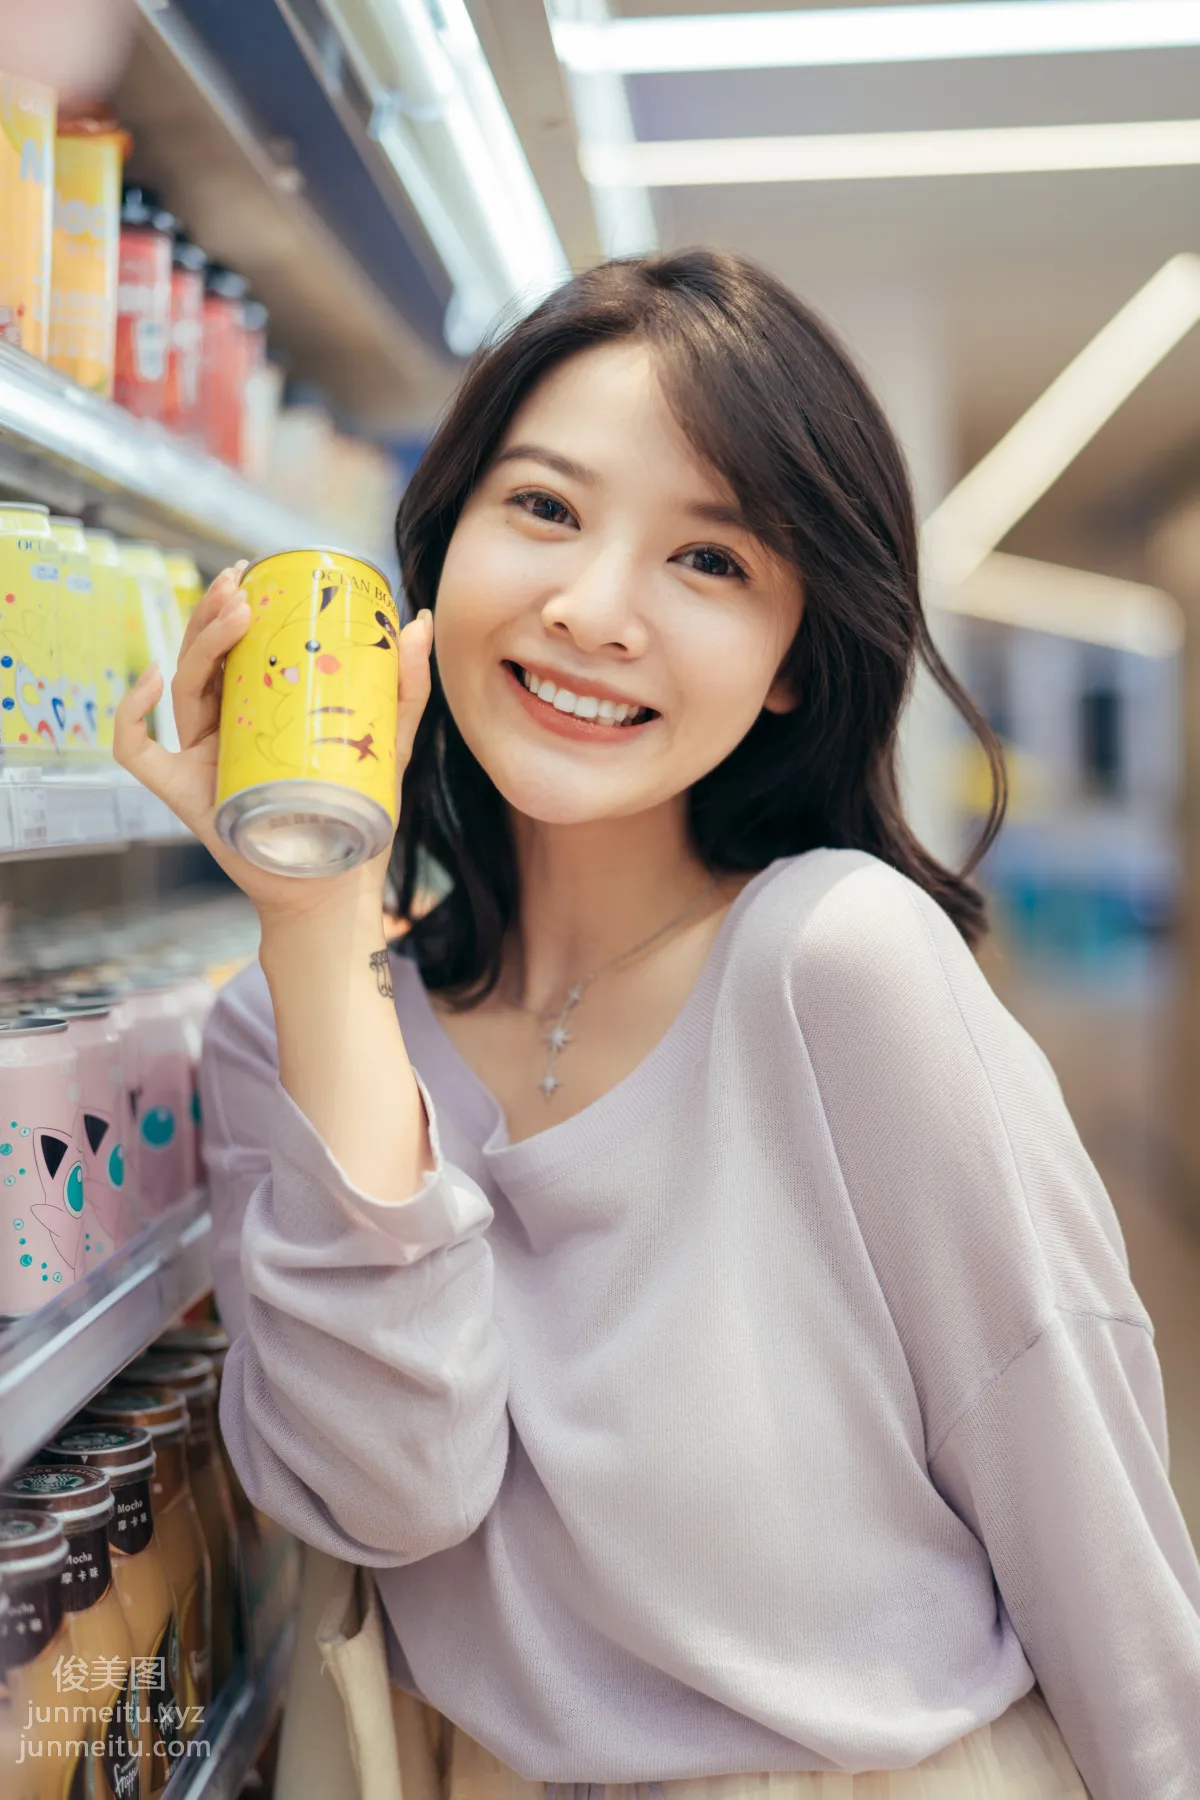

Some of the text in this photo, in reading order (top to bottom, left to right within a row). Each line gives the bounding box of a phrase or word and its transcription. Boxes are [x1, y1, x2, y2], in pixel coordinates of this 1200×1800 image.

[117, 1499, 143, 1514] Mocha
[118, 1512, 148, 1532] 摩卡味
[60, 1566, 99, 1585] 摩卡味
